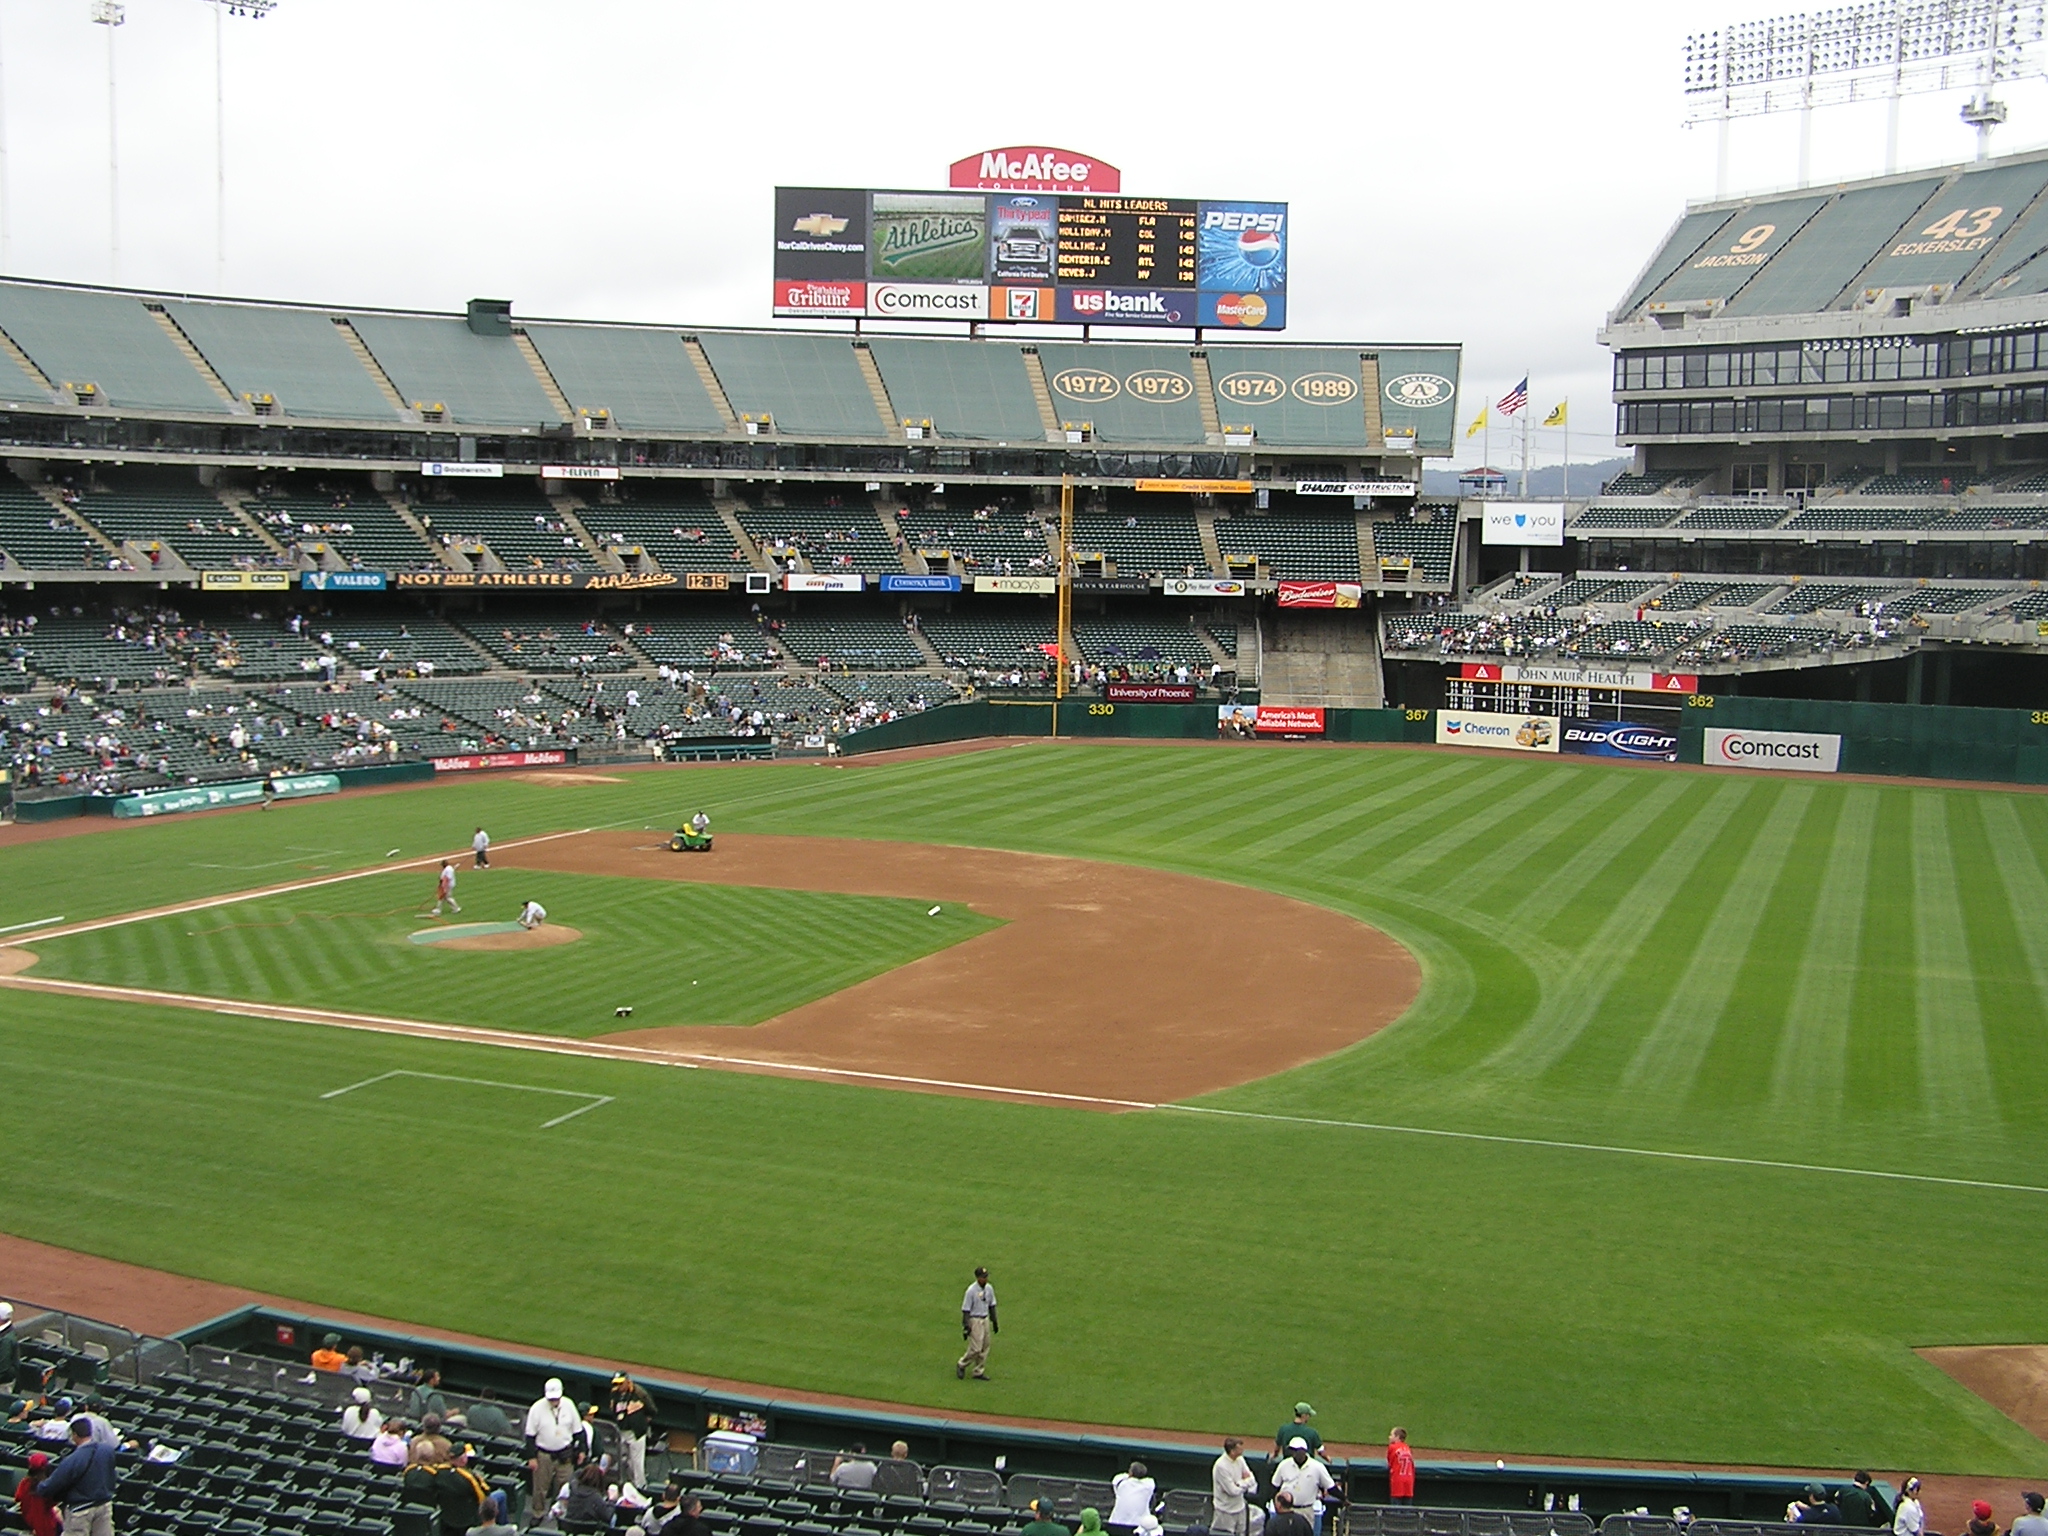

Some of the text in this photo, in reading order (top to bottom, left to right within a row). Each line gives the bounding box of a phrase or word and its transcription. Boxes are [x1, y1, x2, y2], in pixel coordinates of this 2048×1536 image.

[979, 152, 1089, 182] McAfee
[977, 182, 1091, 191] COLISEUM
[1084, 198, 1168, 211] NL HITS LEADERS
[1139, 216, 1155, 226] FLA
[1205, 211, 1283, 232] PEPSI
[1921, 207, 2003, 239] 43
[884, 219, 977, 251] Athletics
[1139, 229, 1155, 239] COL
[1730, 225, 1776, 253] 9
[1890, 237, 1993, 256] ECKERSLEY
[1138, 257, 1155, 267] ATL
[1694, 253, 1768, 268] JACKSON
[788, 288, 850, 306] Tribune
[1217, 304, 1266, 315] MasterCard
[1061, 376, 1113, 393] 1972
[1133, 377, 1185, 395] 1973
[1226, 379, 1278, 396] 1974
[1300, 379, 1350, 397] 1989
[1300, 483, 1347, 493] SHAMES
[1490, 515, 1556, 528] we you
[333, 575, 381, 586] VALERO
[399, 573, 574, 585] NOT JUST ATHLETES
[690, 576, 724, 588] 12:15
[999, 579, 1040, 591] macy's
[1098, 582, 1146, 590] WEARHOUSE
[1279, 588, 1335, 602] Budweiser
[1517, 668, 1635, 685] JOHN MUIR HEALTH
[1109, 687, 1191, 699] University of Phoenix
[1688, 695, 1714, 708] 362
[1089, 704, 1114, 715] 330
[1260, 711, 1316, 720] America's Most
[1405, 709, 1429, 721] 367
[1257, 719, 1322, 728] Reliable Network.
[1464, 722, 1510, 737] Chevron
[1564, 729, 1677, 747] BUD LIGHT
[434, 758, 471, 770] McAfee
[525, 752, 561, 764] McAfee
